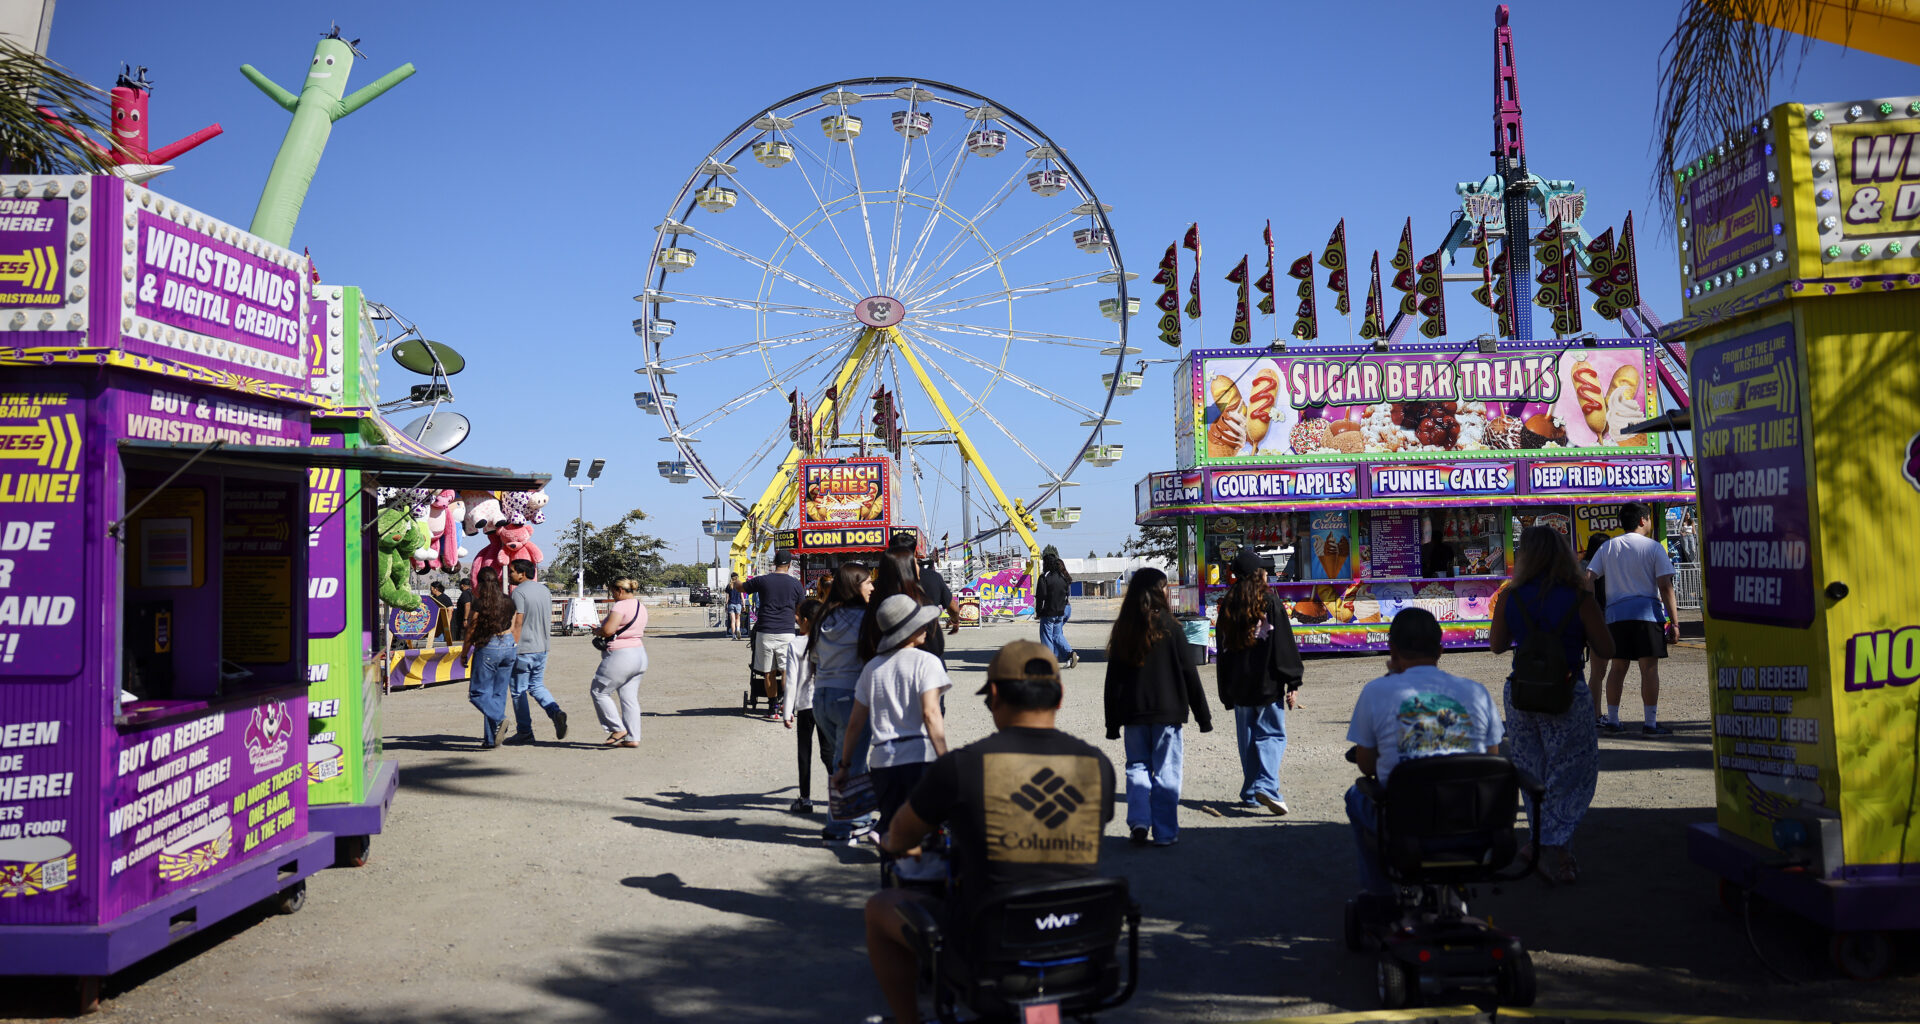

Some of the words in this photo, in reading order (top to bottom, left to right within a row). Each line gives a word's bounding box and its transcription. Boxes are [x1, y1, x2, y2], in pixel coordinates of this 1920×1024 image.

[1848, 187, 1884, 221] &
[145, 226, 296, 312] WRISTBANDS
[139, 273, 156, 304] &
[161, 279, 231, 325] DIGITAL
[234, 303, 299, 346] CREDITS
[1722, 348, 1743, 365] FRONT
[1744, 344, 1753, 358] OF
[1755, 341, 1768, 354] THE
[1769, 336, 1786, 351] LINE
[1734, 353, 1774, 374] WRISTBAND
[1290, 362, 1382, 406] SUGAR
[1385, 361, 1456, 400] BEAR
[1460, 355, 1559, 400] TREATS
[1, 392, 29, 406] THE
[32, 392, 69, 406] LINE
[151, 388, 192, 417] BUY
[194, 399, 211, 421] &
[214, 401, 283, 432] REDEEM
[1702, 428, 1730, 458] SKIP
[1732, 423, 1757, 454] THE
[1761, 416, 1799, 451] LINE!
[0, 473, 80, 503] LINE!
[808, 467, 878, 481] FRENCH
[820, 480, 869, 494] FRIES
[1160, 476, 1182, 489] ICE
[1216, 473, 1291, 498] GOURMET
[1295, 472, 1352, 496] APPLES
[1379, 469, 1445, 493] FUNNEL
[1449, 467, 1509, 491] CAKES
[1533, 466, 1564, 488] DEEP
[1567, 466, 1603, 487] FRIED
[1606, 464, 1671, 486] DESSERTS
[1714, 466, 1790, 501] UPGRADE
[1153, 487, 1199, 502] CREAM
[1311, 519, 1347, 530] Cream
[1323, 511, 1343, 523] Ice
[1731, 504, 1774, 535] YOUR
[805, 532, 842, 546] CORN
[846, 530, 882, 545] DOGS
[1710, 540, 1806, 571] WRISTBAND
[980, 582, 1028, 600] GIANT
[1734, 575, 1782, 607] HERE!
[1304, 633, 1331, 644] TREATS
[1718, 667, 1739, 689] BUY
[1741, 667, 1756, 689] OR
[1758, 665, 1809, 690] REDEEM
[1732, 694, 1772, 712] UNLIMITED
[1773, 695, 1793, 714] RIDE
[1715, 714, 1778, 739] WRISTBAND
[1780, 717, 1819, 744] HERE!
[118, 740, 150, 777] BUY
[151, 731, 171, 762] OR
[173, 712, 225, 752] REDEEM
[137, 755, 187, 793] UNLIMITED
[189, 745, 209, 770] RIDE
[109, 775, 192, 838] WRISTBAND
[194, 756, 231, 795] HERE!
[233, 792, 246, 815] NO
[247, 781, 271, 807] MORE
[272, 762, 303, 793] TICKETS
[135, 824, 152, 845] ADD
[153, 809, 181, 836] DIGITAL
[182, 795, 210, 820] TICKETS
[248, 805, 265, 828] ONE
[266, 790, 290, 815] BAND,
[24, 819, 67, 838] FOOD!
[110, 854, 127, 877] FOR
[166, 820, 193, 847] GAMES
[192, 815, 208, 833] AND
[208, 801, 229, 827] FOOD!
[243, 830, 260, 853] ALL
[261, 819, 276, 840] THE
[277, 807, 296, 832] FUN!
[999, 831, 1093, 852] Columbia
